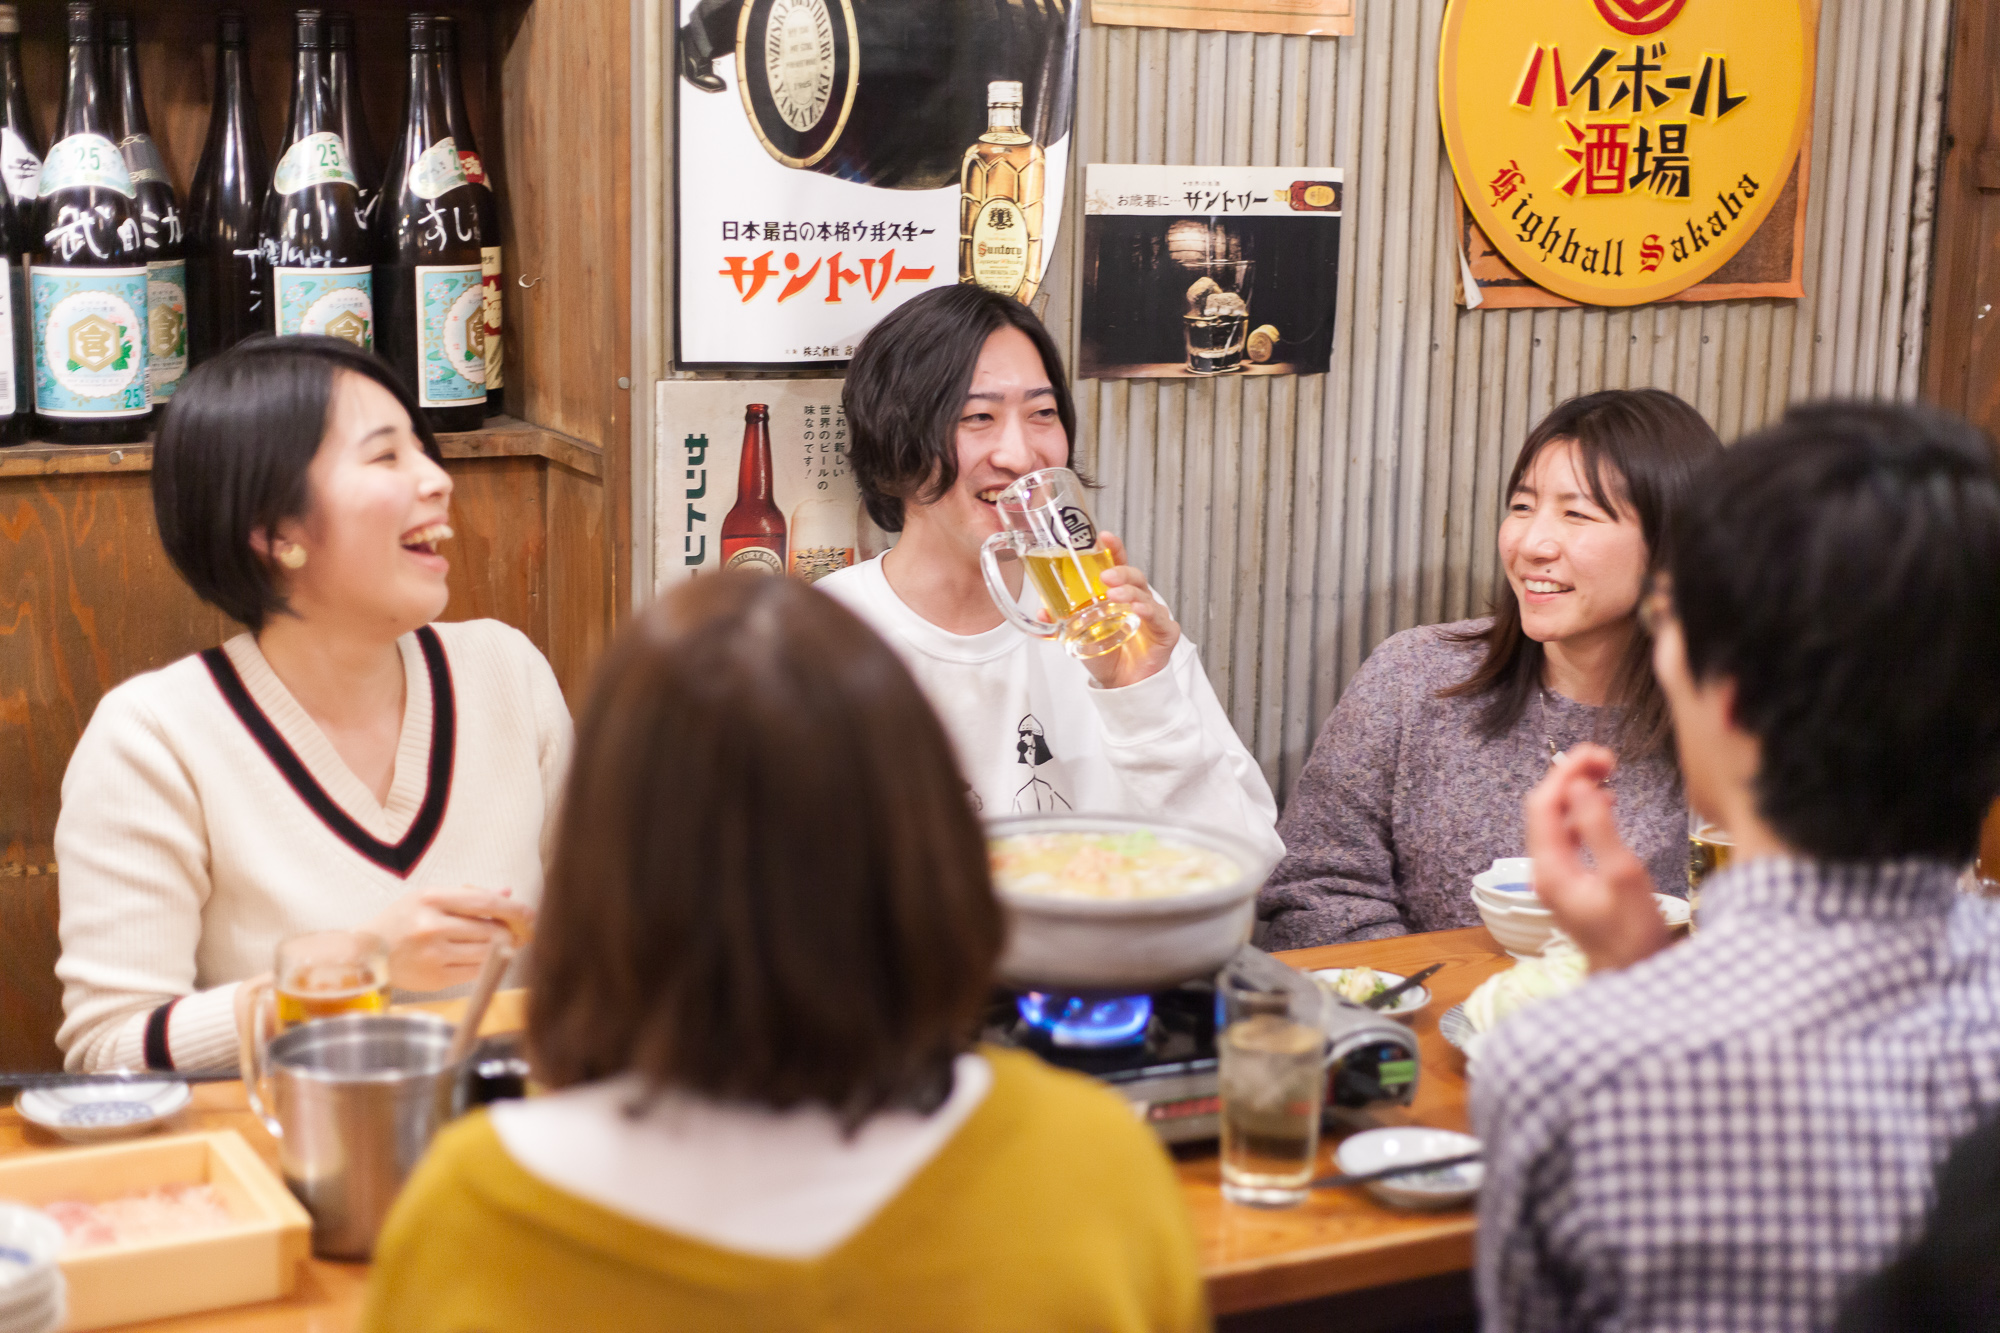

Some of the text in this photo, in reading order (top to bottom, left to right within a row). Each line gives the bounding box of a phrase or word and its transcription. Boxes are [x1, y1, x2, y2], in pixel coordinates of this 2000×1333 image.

[1515, 41, 1748, 118] ハイボール
[74, 147, 100, 170] 25
[316, 144, 340, 167] 25
[1561, 119, 1690, 198] 酒場
[1183, 190, 1269, 212] サントリー
[1489, 160, 1760, 277] Highball Sakaba
[722, 220, 936, 242] 日本最古の本格ウヰスキー
[977, 241, 1022, 258] Suntory
[718, 248, 935, 303] サントリー
[125, 388, 141, 409] 25
[817, 405, 831, 491] 世界のビールの
[833, 405, 847, 477] これが新しい
